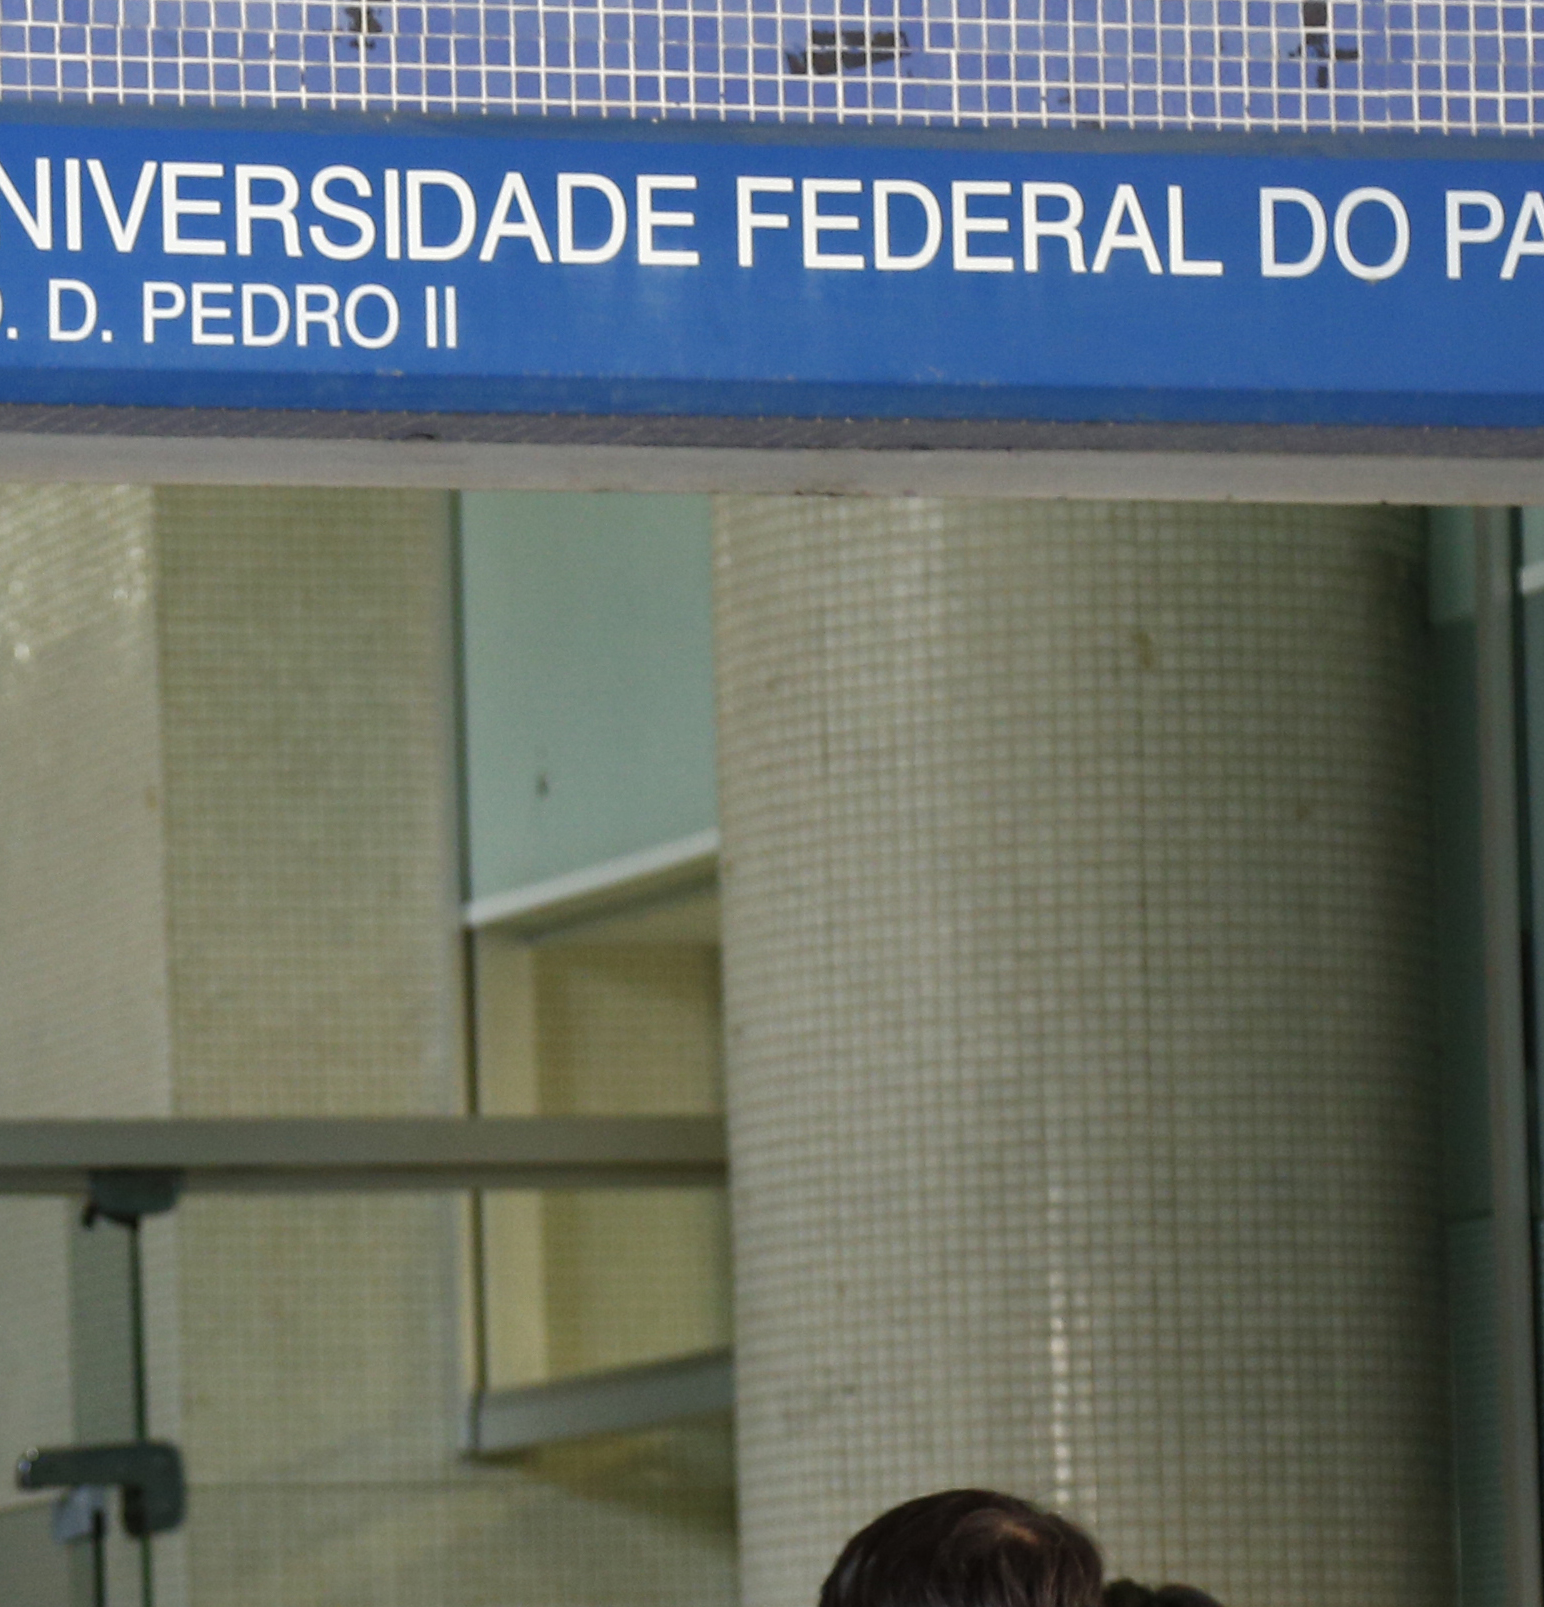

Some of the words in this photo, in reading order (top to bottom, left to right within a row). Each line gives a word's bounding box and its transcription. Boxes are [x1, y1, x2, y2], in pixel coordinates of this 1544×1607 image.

[736, 175, 1224, 277] FEDERAL
[1259, 186, 1410, 281] DO
[48, 278, 113, 343] D.
[142, 281, 400, 349] PEDRO
[425, 285, 458, 349] II
